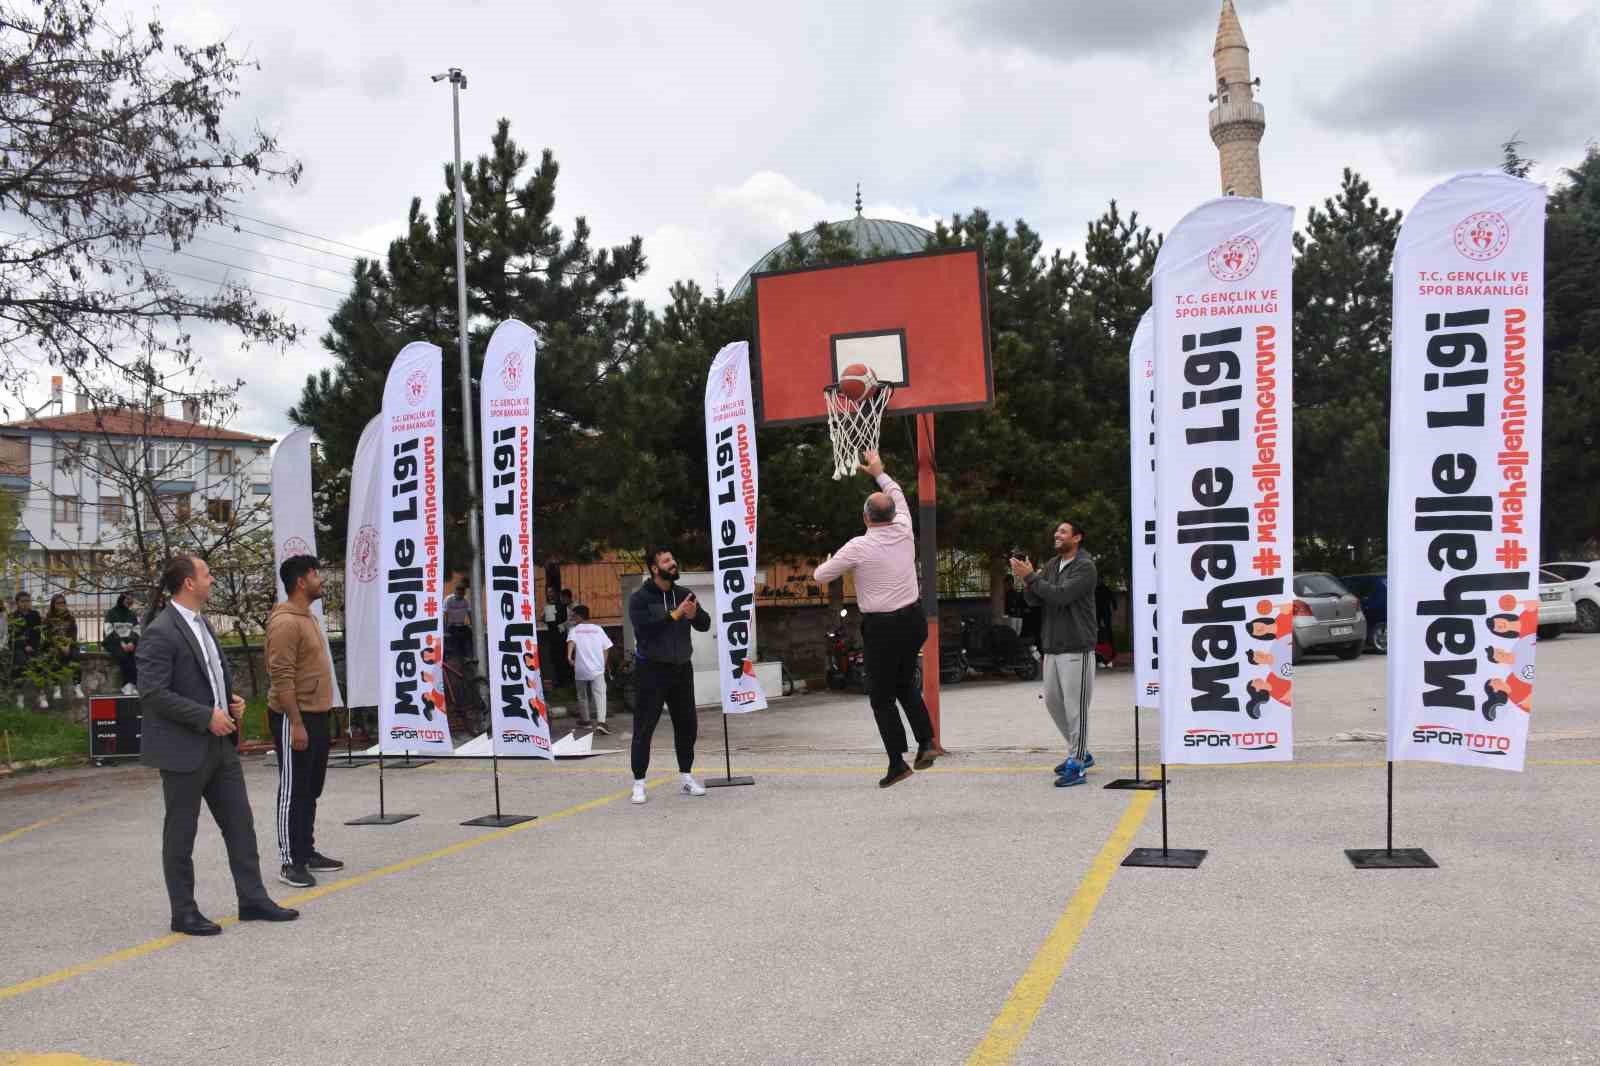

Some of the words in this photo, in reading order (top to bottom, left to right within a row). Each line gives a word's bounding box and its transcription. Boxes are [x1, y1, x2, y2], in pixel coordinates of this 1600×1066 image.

[1175, 295, 1198, 305] T.C.
[1201, 289, 1256, 305] GENÇLİK
[1261, 289, 1278, 300] VE
[1175, 307, 1208, 318] SPOR
[1211, 303, 1278, 317] BAKANLIĞI
[1418, 272, 1442, 282] T.C.
[1447, 269, 1506, 284] GENÇLİK
[1511, 272, 1528, 282] VE
[1419, 285, 1453, 296] SPOR
[1457, 283, 1529, 296] BAKANLIĞI
[1182, 326, 1242, 445] Ligi
[1424, 309, 1490, 428] Ligi
[392, 438, 420, 523] Ligi
[493, 426, 517, 516] Ligi
[715, 425, 736, 506] Ligi
[718, 519, 754, 679] Mahalle
[1177, 467, 1284, 712] Mahalle
[1415, 453, 1530, 712] Mahalle
[388, 538, 439, 716] Mahalle
[492, 534, 534, 719] Mahalle
[1184, 732, 1278, 747] SPORTOTO
[1413, 731, 1510, 750] SPORTOTO
